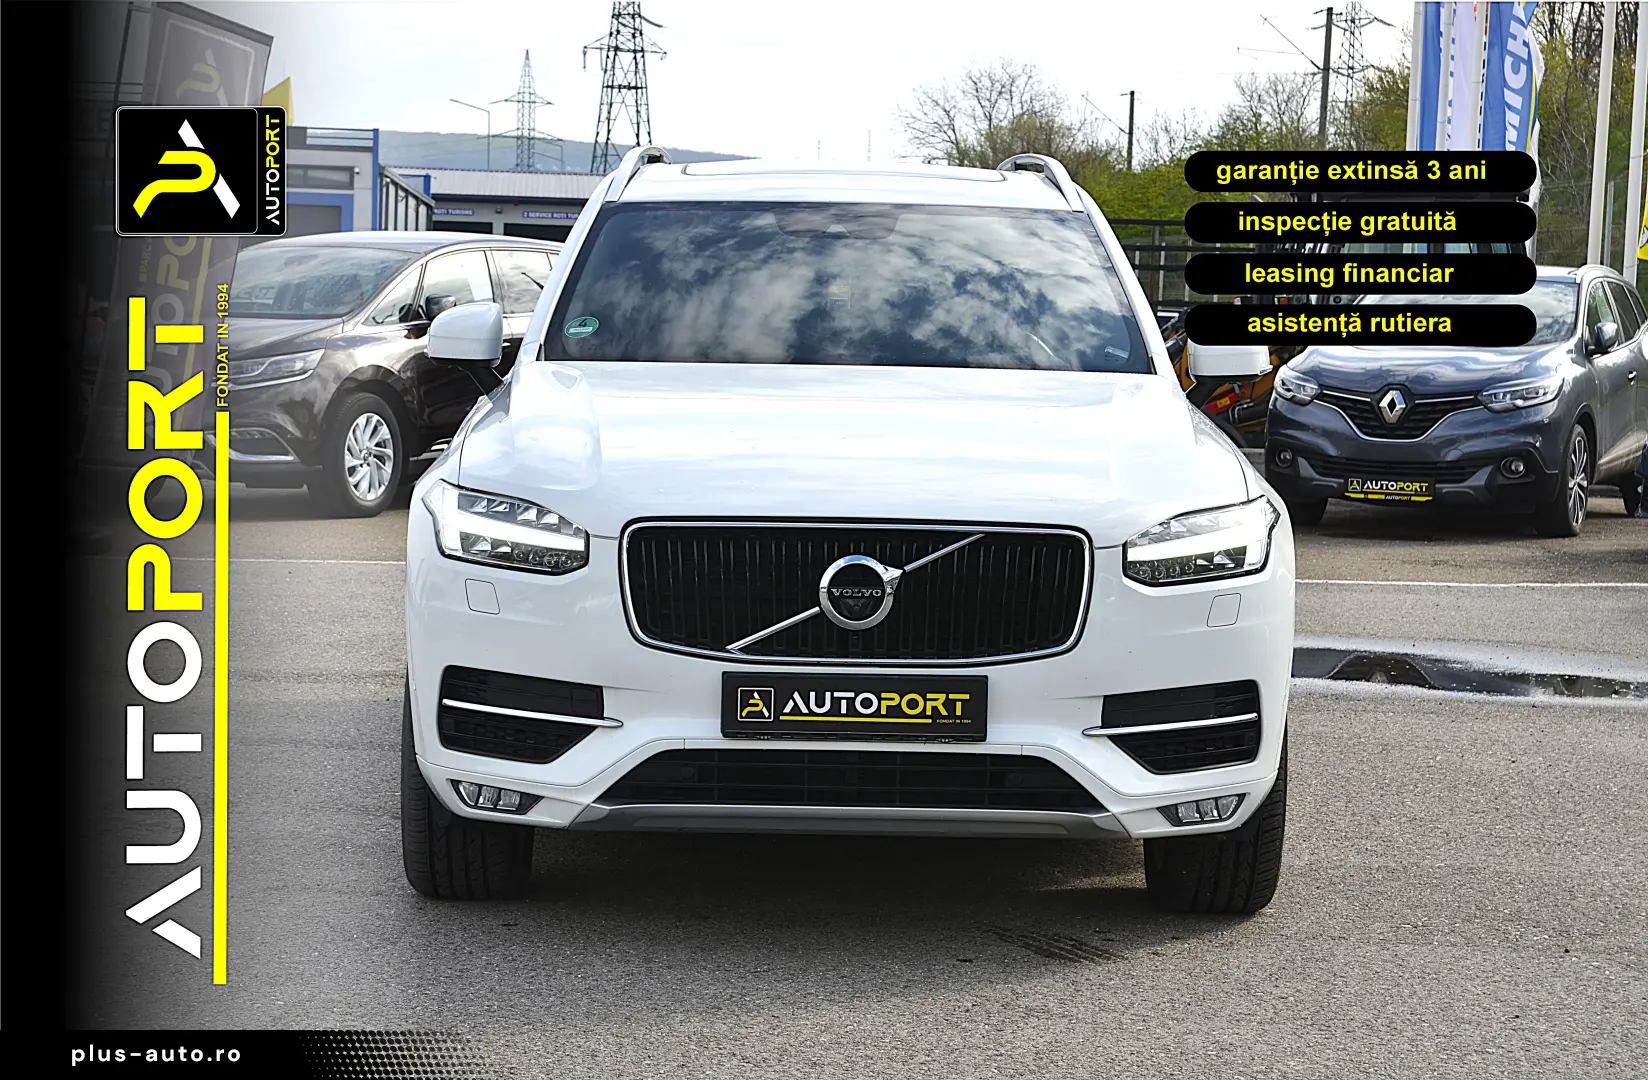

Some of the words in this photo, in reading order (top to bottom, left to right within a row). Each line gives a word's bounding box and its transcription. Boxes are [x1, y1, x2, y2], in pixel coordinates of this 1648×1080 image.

[1363, 480, 1429, 492] AUTOPORT
[830, 588, 882, 597] VOLVO
[782, 690, 970, 716] AUTOPORT
